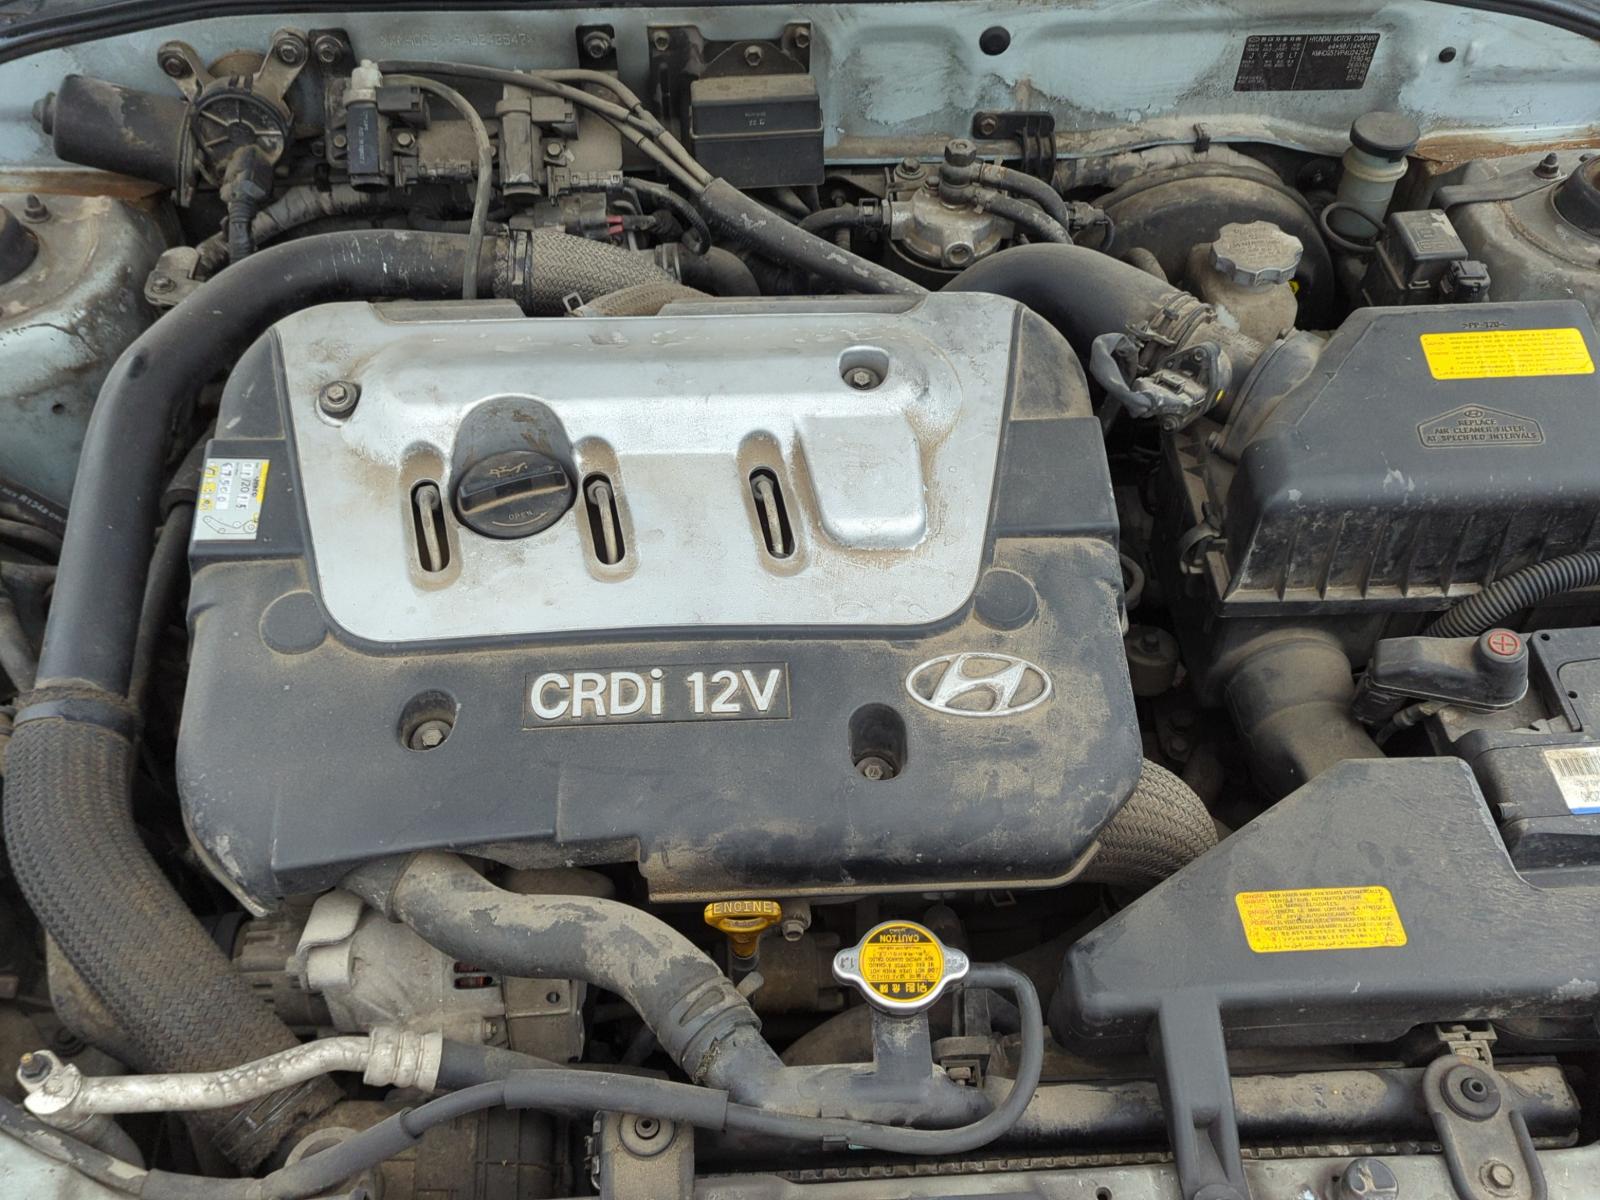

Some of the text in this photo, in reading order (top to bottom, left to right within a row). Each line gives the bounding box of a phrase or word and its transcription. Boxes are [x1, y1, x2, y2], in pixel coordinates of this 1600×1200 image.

[1453, 426, 1493, 434] CLEANER
[1426, 432, 1536, 442] AT SPECIFIED INTERVALS
[508, 510, 534, 521] OPEN
[531, 668, 780, 719] CRDi 12V
[713, 901, 772, 913] ENGINE
[879, 934, 919, 942] CAUTION
